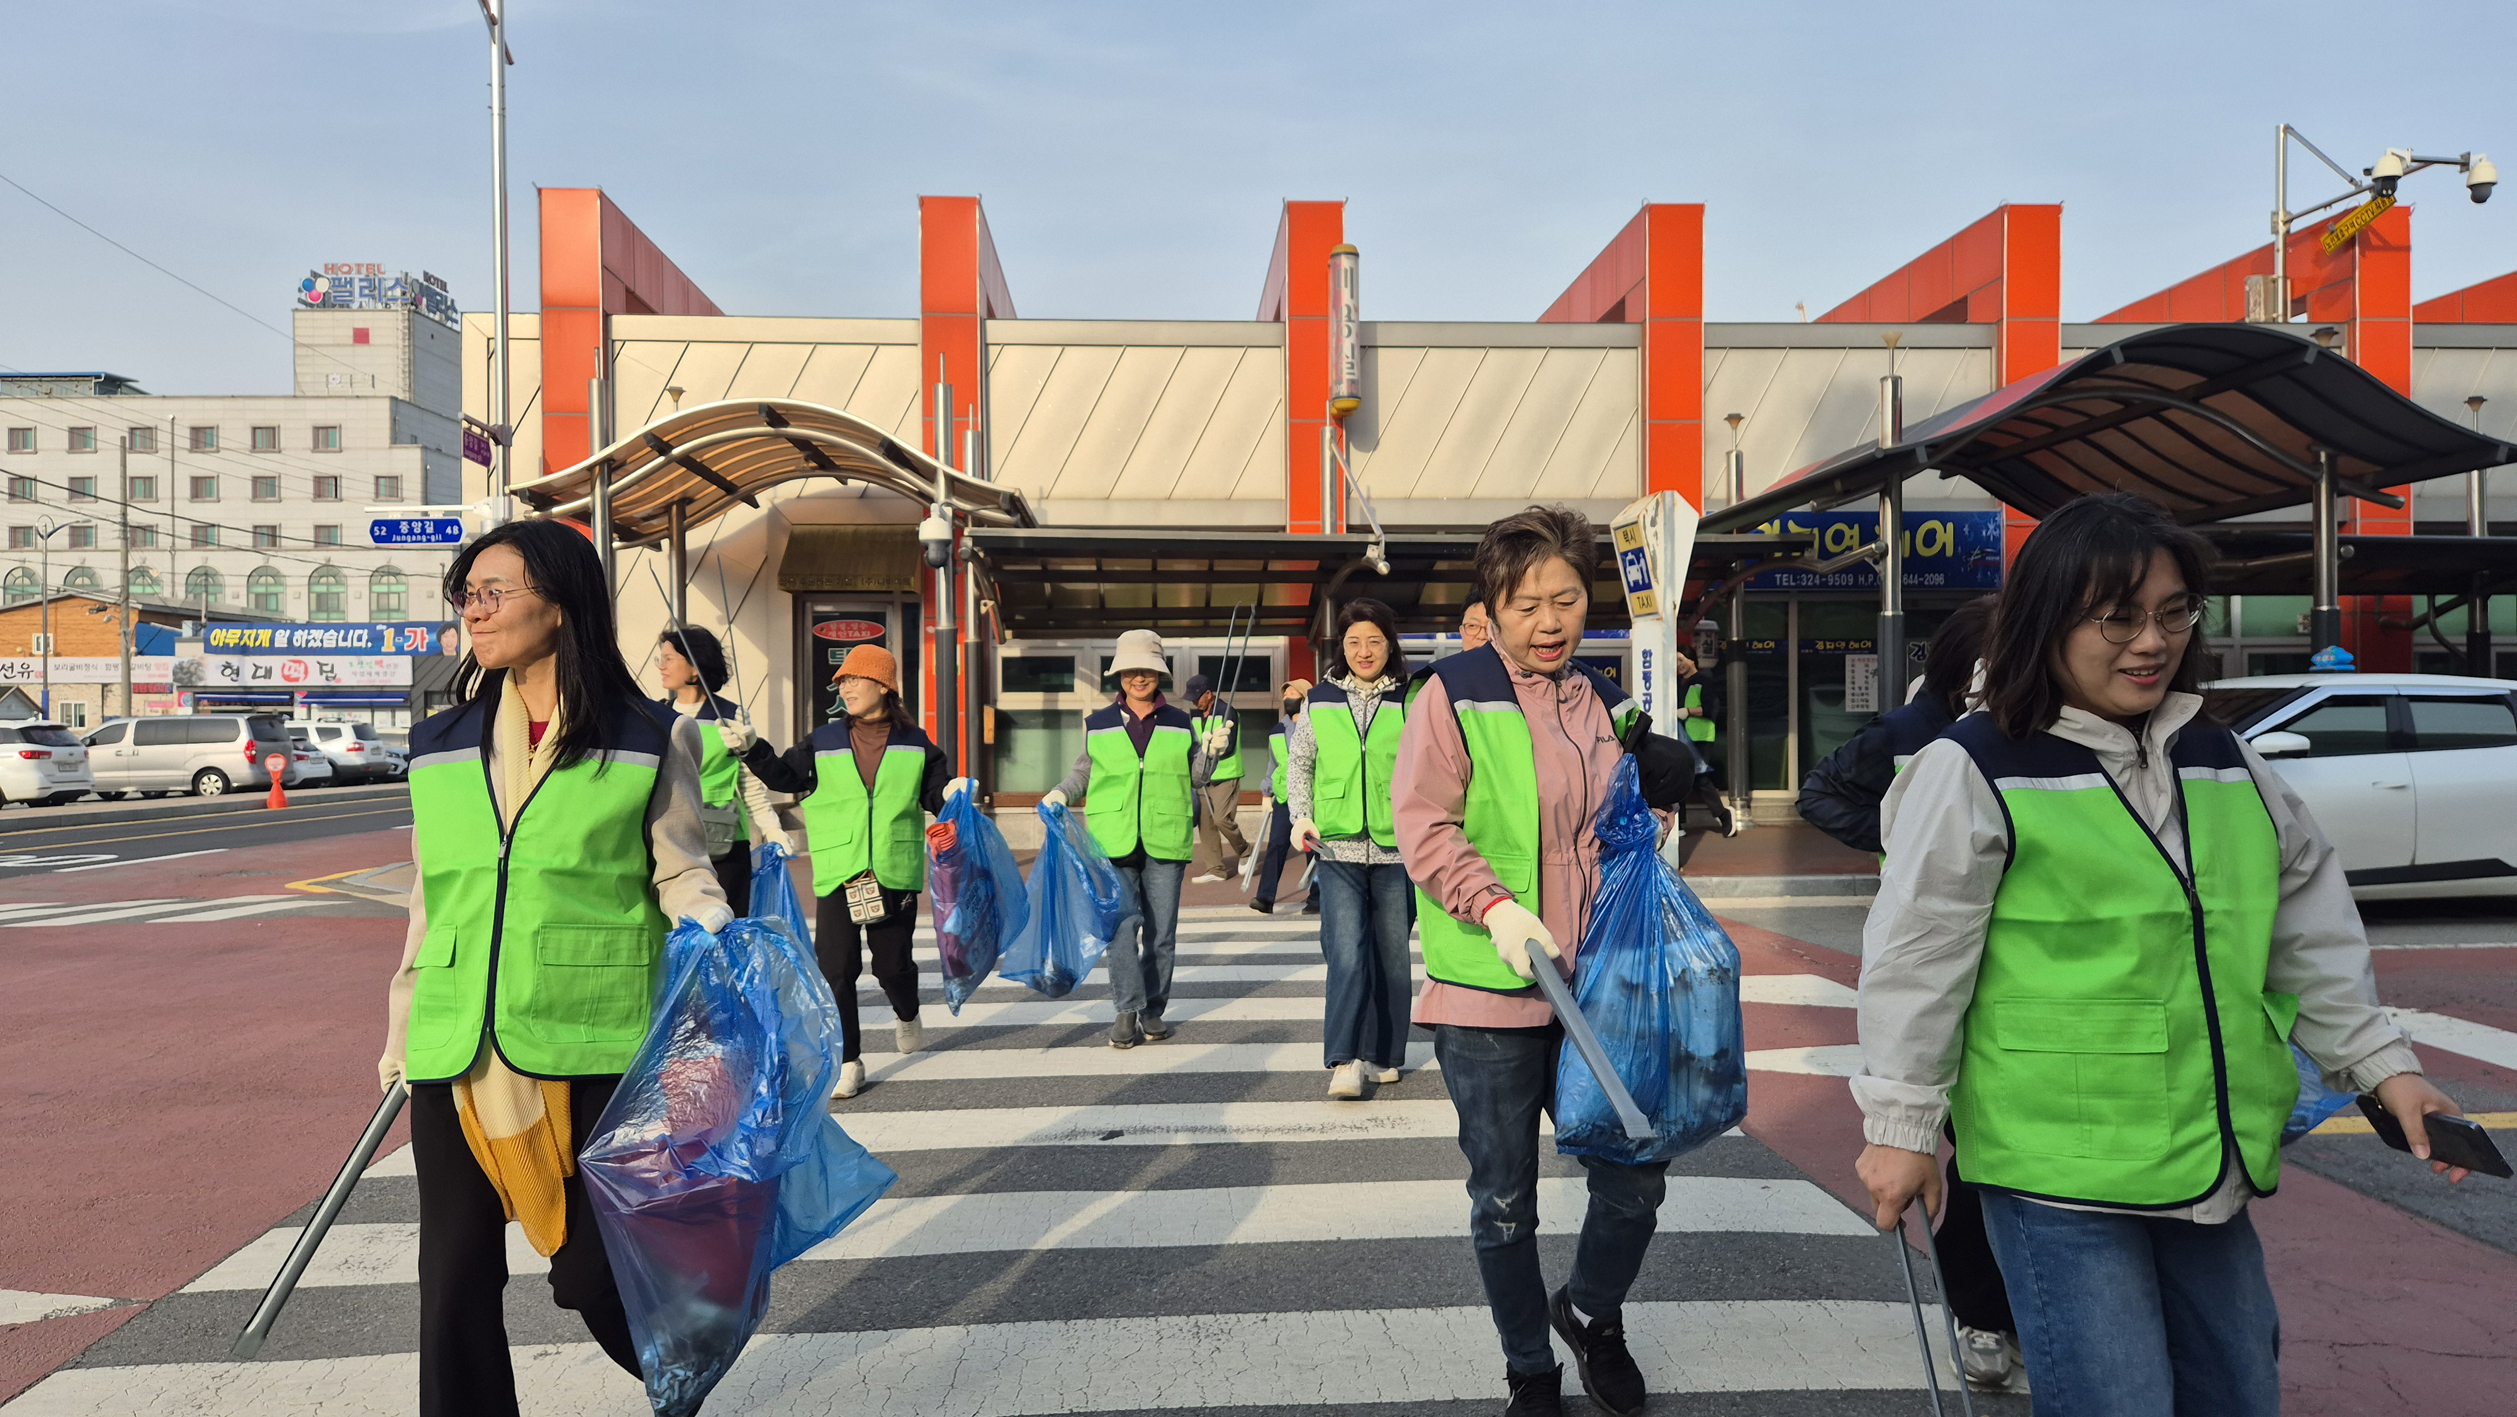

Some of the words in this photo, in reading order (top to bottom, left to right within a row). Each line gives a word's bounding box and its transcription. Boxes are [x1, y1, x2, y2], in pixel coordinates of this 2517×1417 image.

[324, 263, 386, 275] HOTEL
[423, 270, 449, 294] HOTEL
[331, 277, 411, 303] 팰리스
[373, 526, 387, 536] 52
[399, 520, 434, 534] 중앙길
[445, 525, 460, 535] 48
[392, 533, 442, 542] Jungang-gil
[1622, 527, 1637, 545] 택시
[1775, 573, 1854, 586] TEL:324-9509
[1636, 595, 1653, 610] TAXI
[210, 628, 272, 648] 야무지게
[274, 629, 290, 648] 일
[292, 629, 372, 648] 하겠습니다.
[381, 627, 429, 652] 1-가
[1596, 734, 1615, 744] FILA
